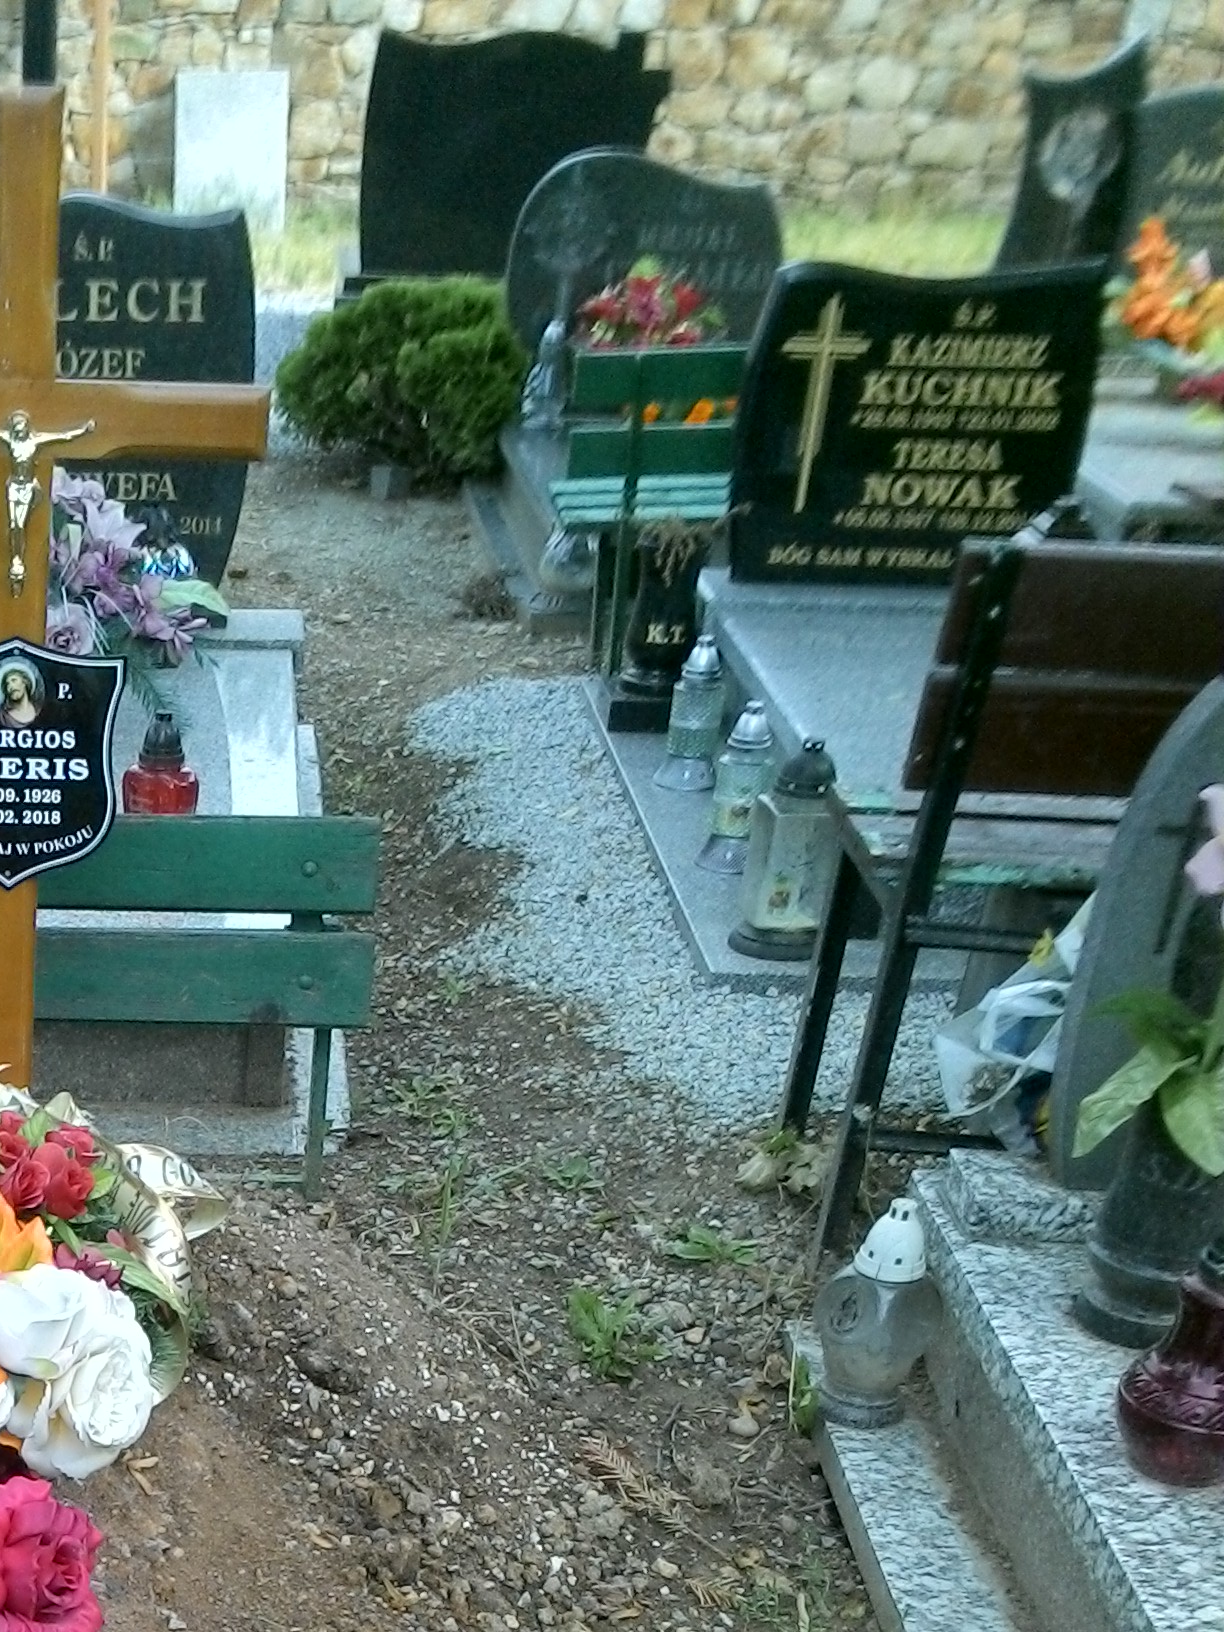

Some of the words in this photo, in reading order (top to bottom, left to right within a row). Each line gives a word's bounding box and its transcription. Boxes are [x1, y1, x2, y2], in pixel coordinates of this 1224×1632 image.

[55, 341, 146, 378] ÓZEF
[887, 333, 1051, 368] KAZIMIERZ
[859, 371, 1065, 407] KUCHNIK
[892, 438, 1003, 470] TERESA
[861, 473, 1022, 508] NOWAK
[815, 546, 864, 567] SAM
[58, 682, 73, 700] P.
[15, 842, 30, 856] W
[34, 824, 94, 856] POKOJU
